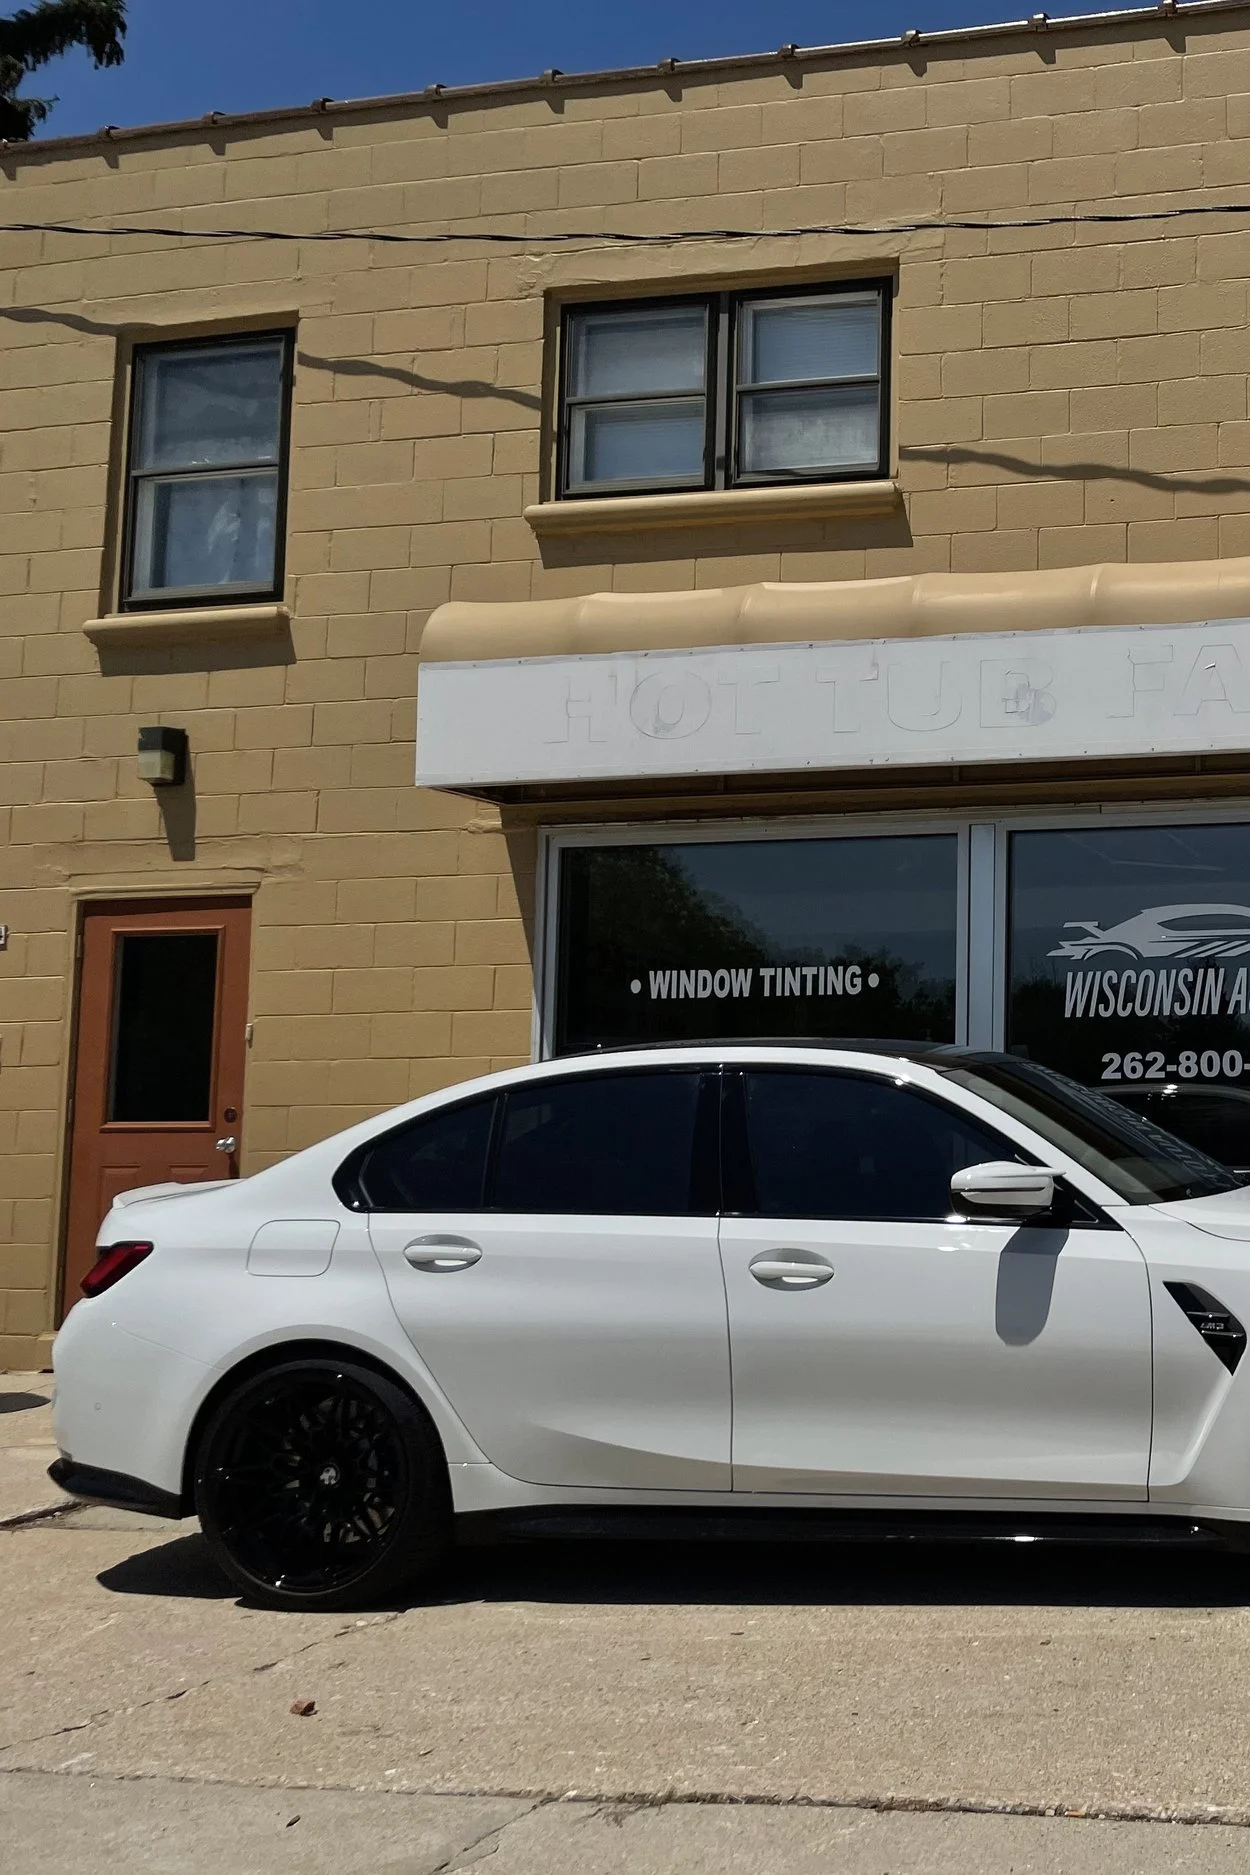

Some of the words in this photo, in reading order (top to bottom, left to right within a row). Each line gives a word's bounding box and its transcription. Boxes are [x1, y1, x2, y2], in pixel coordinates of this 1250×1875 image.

[649, 968, 753, 1000] WINDOW
[759, 965, 862, 997] TINTING
[1064, 967, 1225, 1018] WISCONSIN
